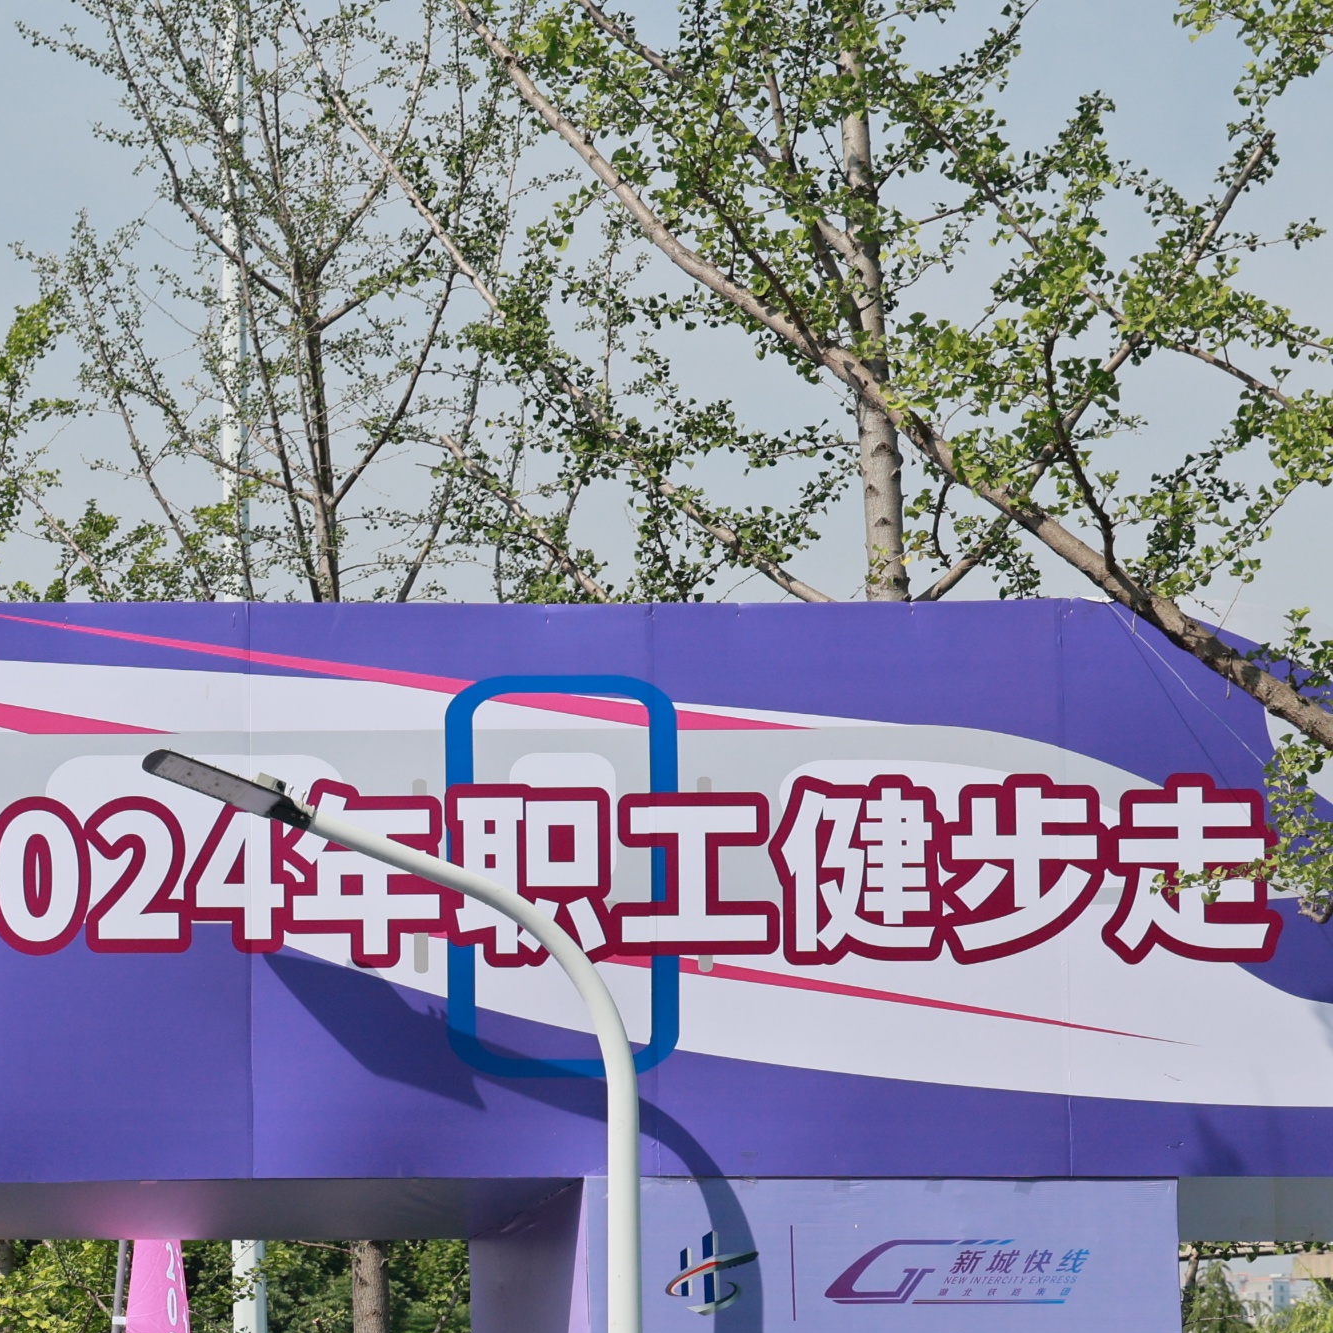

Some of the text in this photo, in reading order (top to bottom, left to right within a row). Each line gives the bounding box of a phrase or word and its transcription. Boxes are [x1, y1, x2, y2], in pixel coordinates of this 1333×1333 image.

[949, 1249, 1090, 1274] 新城快线
[943, 1276, 1078, 1285] NEW INTERCITY EXPRESS
[937, 1288, 1072, 1297] 湖北铁路集团
